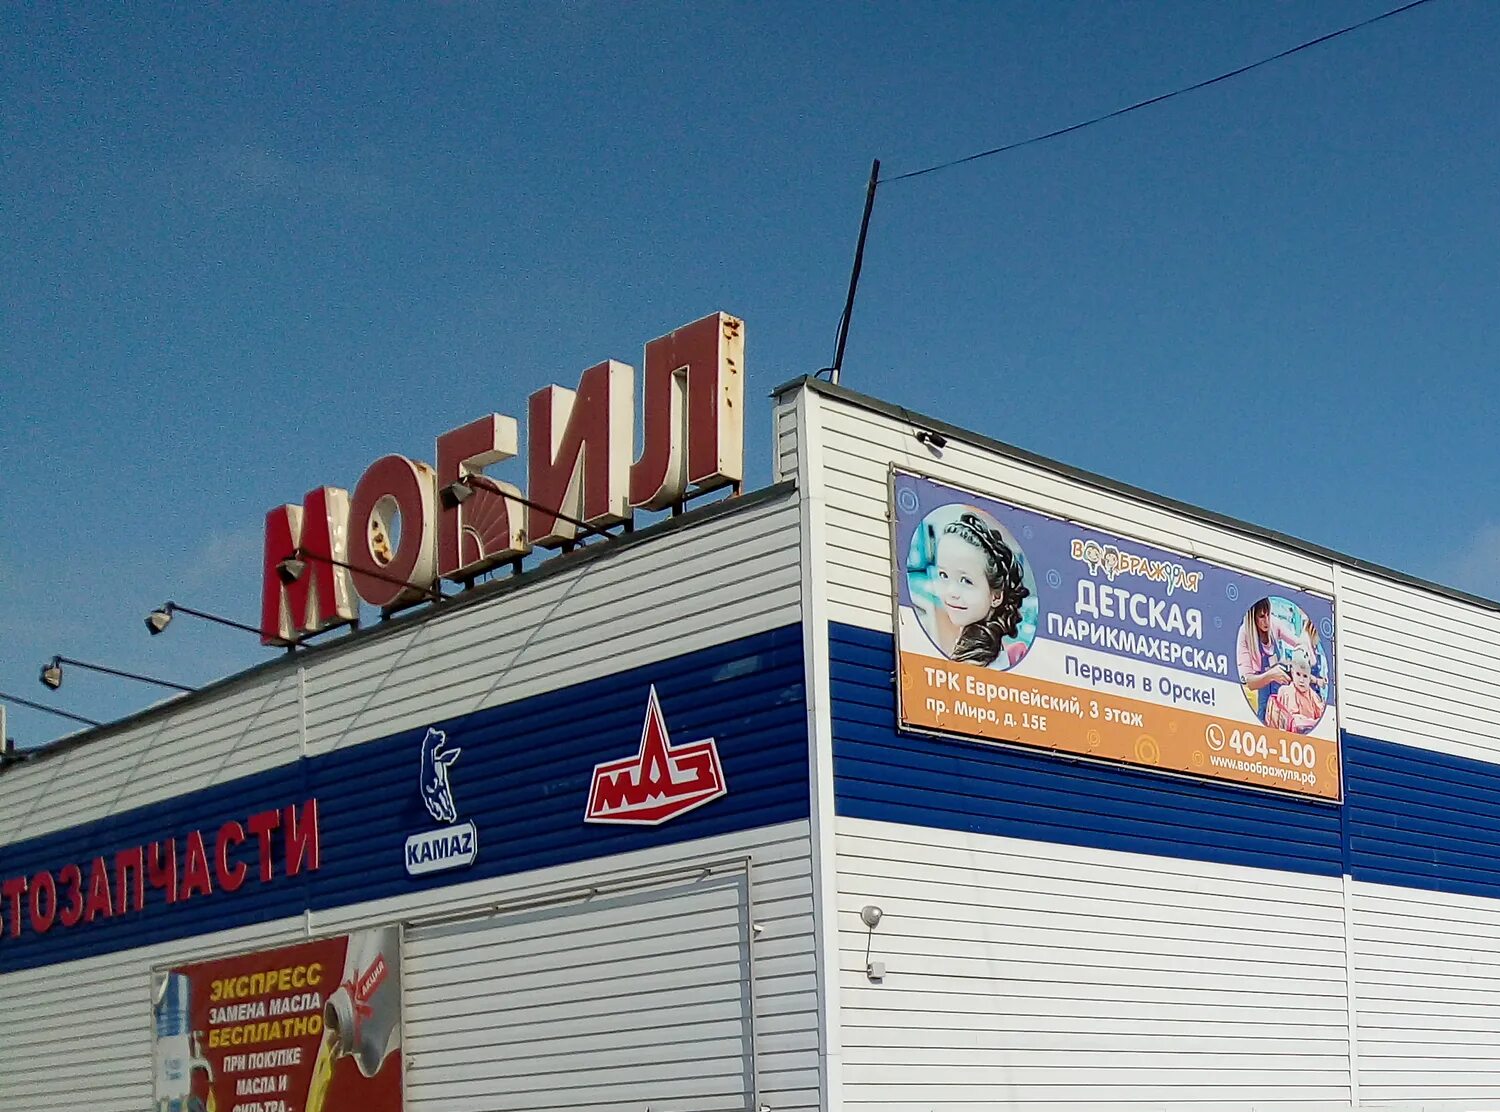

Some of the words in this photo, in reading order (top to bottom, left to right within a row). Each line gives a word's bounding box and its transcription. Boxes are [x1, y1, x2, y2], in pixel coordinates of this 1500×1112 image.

[260, 311, 745, 647] МОБИЛ
[1075, 579, 1203, 640] ДЕТСКАЯ
[1047, 612, 1228, 676] ПАРИКМАХЕРСКАЯ
[923, 667, 960, 692] ТРК
[966, 676, 1084, 719] Европейский,
[1089, 701, 1099, 719] 3
[1104, 706, 1144, 728] этаж
[1065, 655, 1135, 688] Первая
[1143, 677, 1152, 692] в
[1159, 677, 1216, 706] Орске!
[926, 698, 950, 716] пр.
[954, 701, 999, 725] Мира,
[1003, 714, 1018, 727] д.
[1022, 713, 1047, 732] 15Е
[592, 702, 718, 814] МАЗ
[1229, 729, 1316, 769] 404-100
[1210, 755, 1316, 787] www.воображуля.рф
[407, 832, 473, 866] KAMAZ
[0, 798, 320, 940] ТОЗАПЧАСТИ
[210, 963, 322, 1000] ЭКСПРЕСС
[209, 1001, 265, 1025] ЗАМЕНА
[269, 992, 321, 1016] МАСЛА
[209, 1015, 322, 1048] БЕСПЛАТНО
[223, 1054, 246, 1072] ПРИ
[248, 1047, 302, 1070] ПОКУПКЕ
[236, 1076, 275, 1096] МАСЛА
[278, 1074, 288, 1091] И
